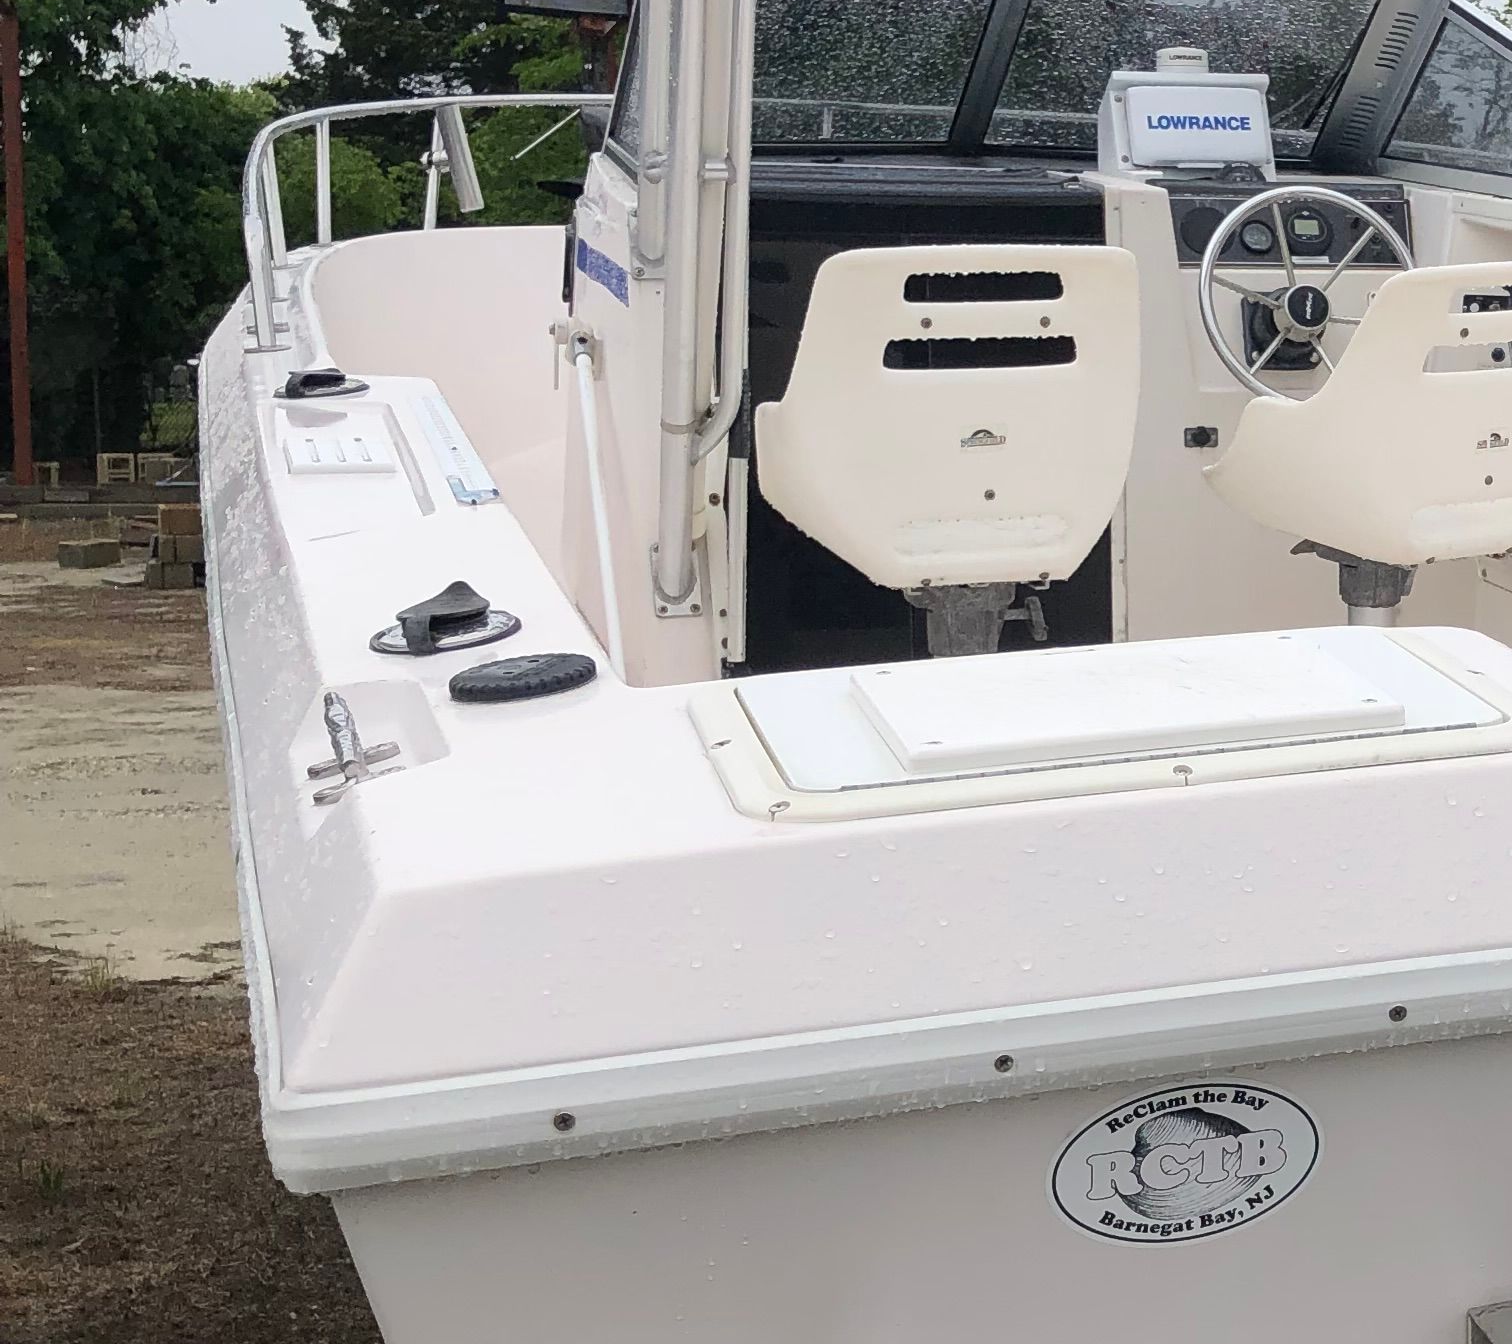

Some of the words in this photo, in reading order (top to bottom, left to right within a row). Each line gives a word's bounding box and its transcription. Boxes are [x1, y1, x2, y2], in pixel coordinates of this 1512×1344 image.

[1147, 115, 1252, 131] LOWRANCE
[1104, 1094, 1188, 1134] ReClam
[1192, 1089, 1228, 1104] the
[1231, 1089, 1270, 1111] Bay
[1085, 1128, 1288, 1201] RCTB
[1098, 1210, 1195, 1237] Barnegat
[1199, 1207, 1245, 1229] Bay,
[1244, 1184, 1276, 1211] NJ
